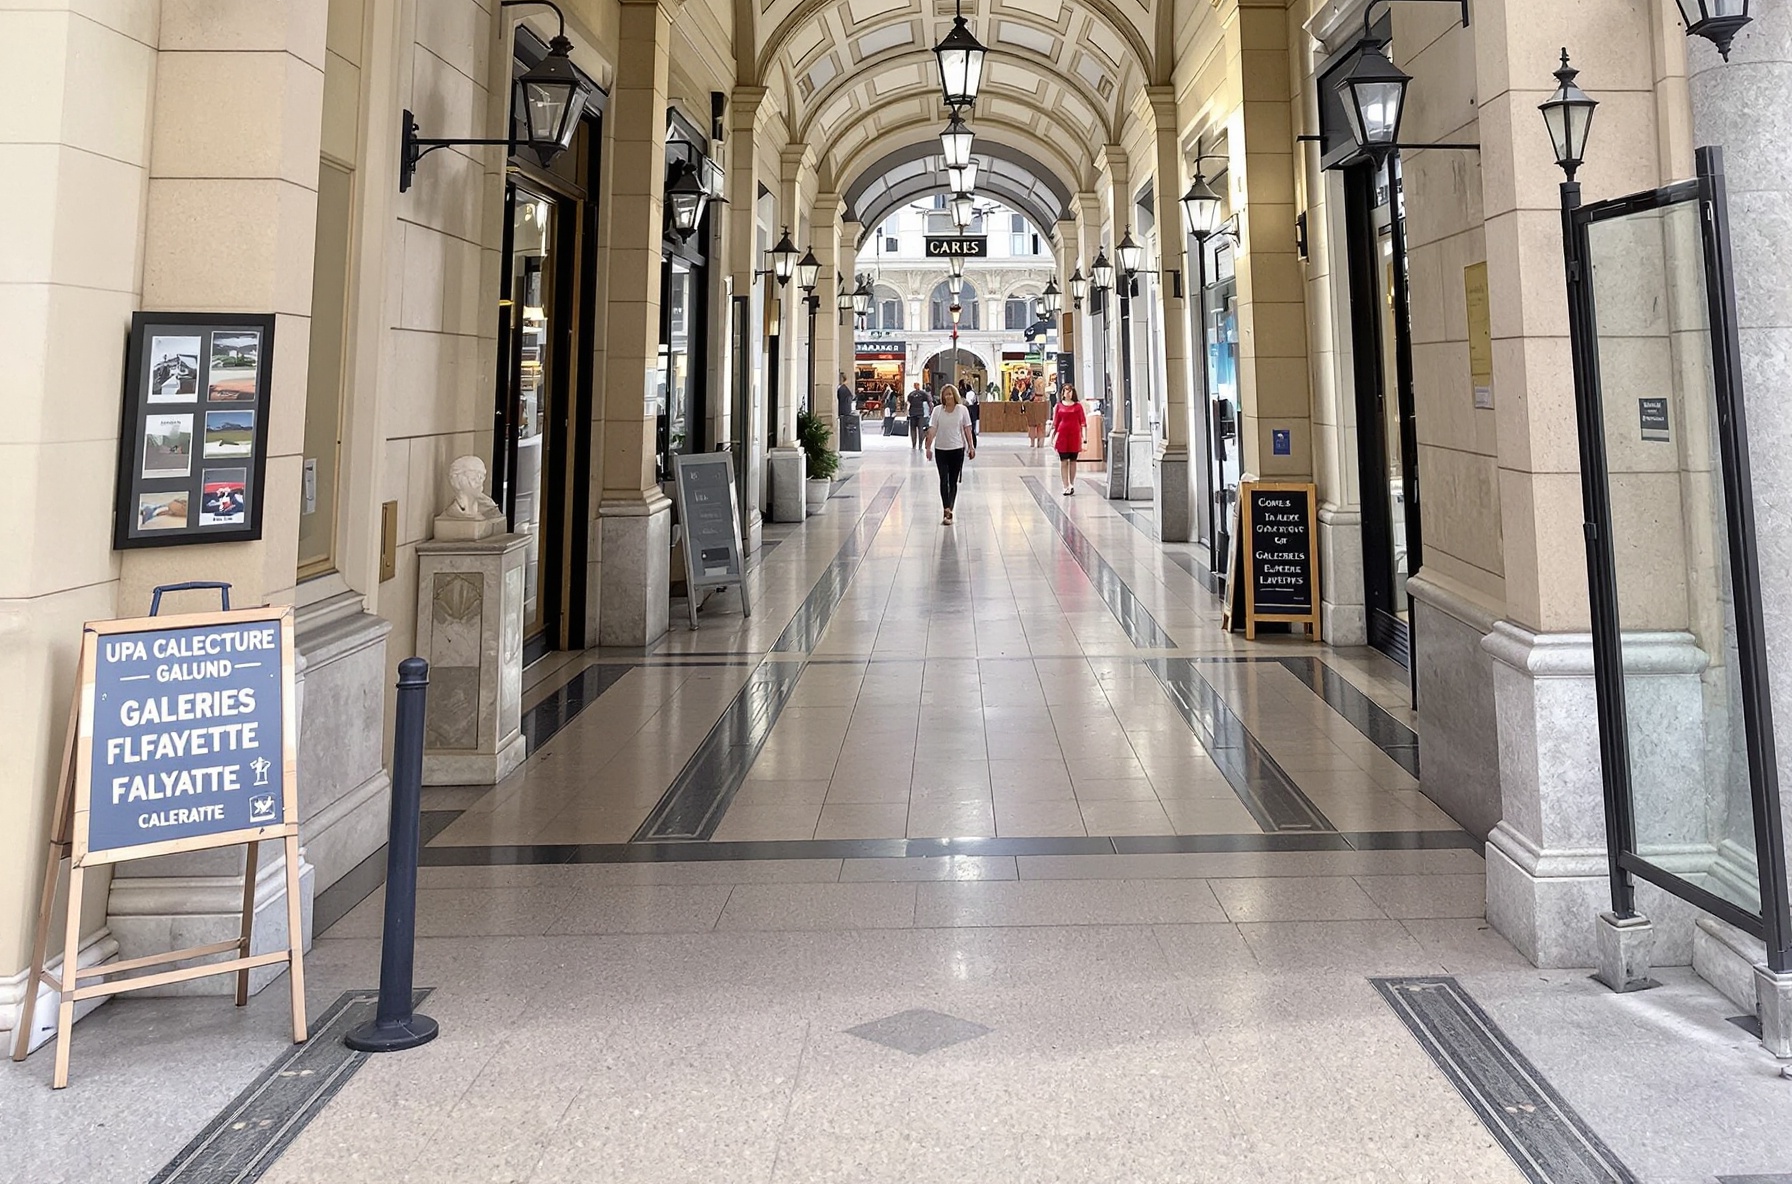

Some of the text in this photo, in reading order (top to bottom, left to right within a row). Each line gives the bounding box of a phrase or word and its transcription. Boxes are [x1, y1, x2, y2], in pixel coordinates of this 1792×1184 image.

[105, 629, 275, 663] UPA CALECTURE
[156, 659, 232, 682] GALUND
[120, 687, 256, 727] GALERIES
[107, 721, 260, 765] FLFAYETTE
[112, 764, 241, 805] FALYATTE
[138, 804, 225, 829] CALERATTE
